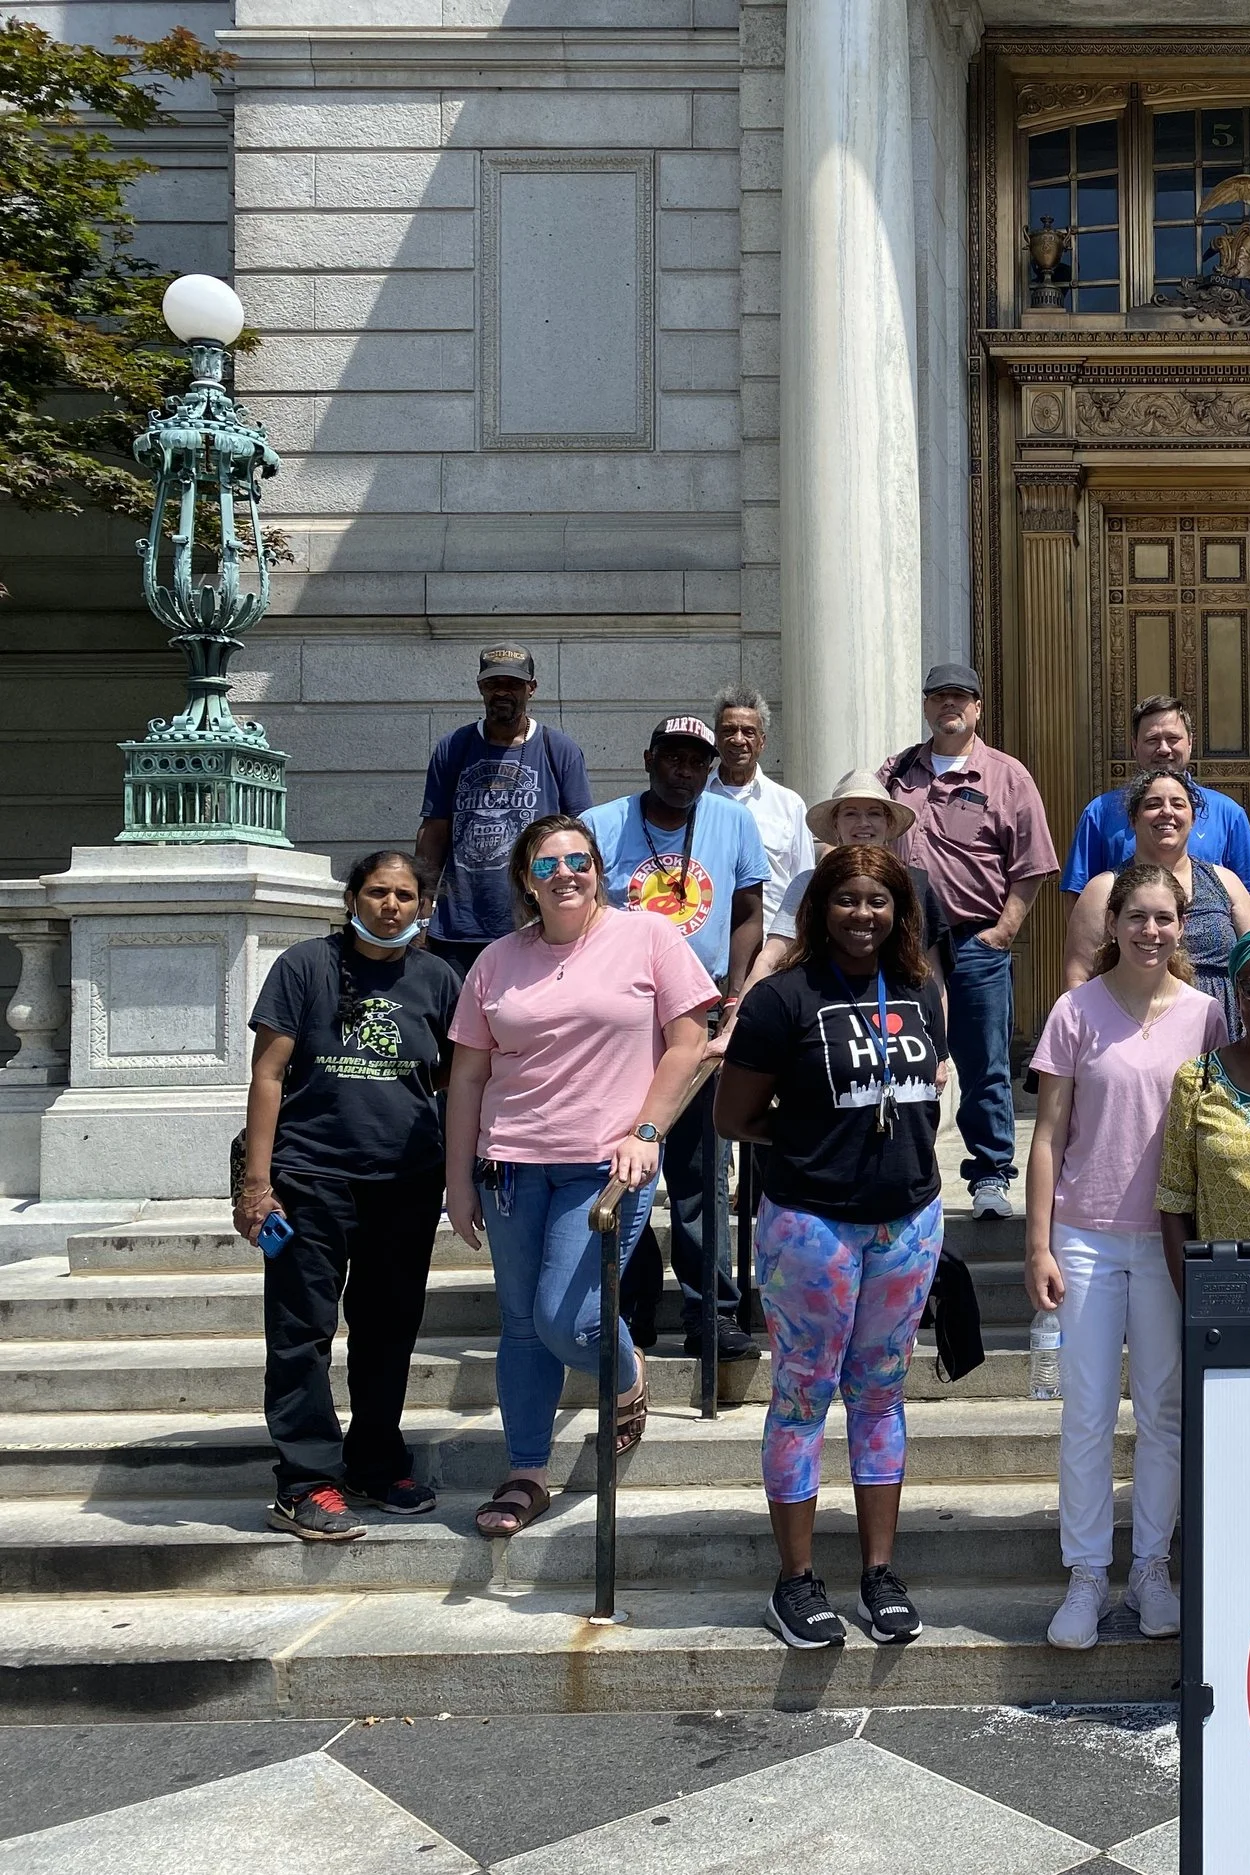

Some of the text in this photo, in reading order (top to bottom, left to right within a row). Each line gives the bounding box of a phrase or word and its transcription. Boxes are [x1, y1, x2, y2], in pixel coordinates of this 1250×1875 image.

[1210, 275, 1233, 286] POST
[456, 789, 538, 811] CHICAGO
[475, 825, 503, 835] 100
[689, 903, 710, 932] ALE
[848, 1035, 927, 1068] HFD
[806, 1611, 836, 1625] PUMA
[879, 1605, 909, 1617] PUMA
